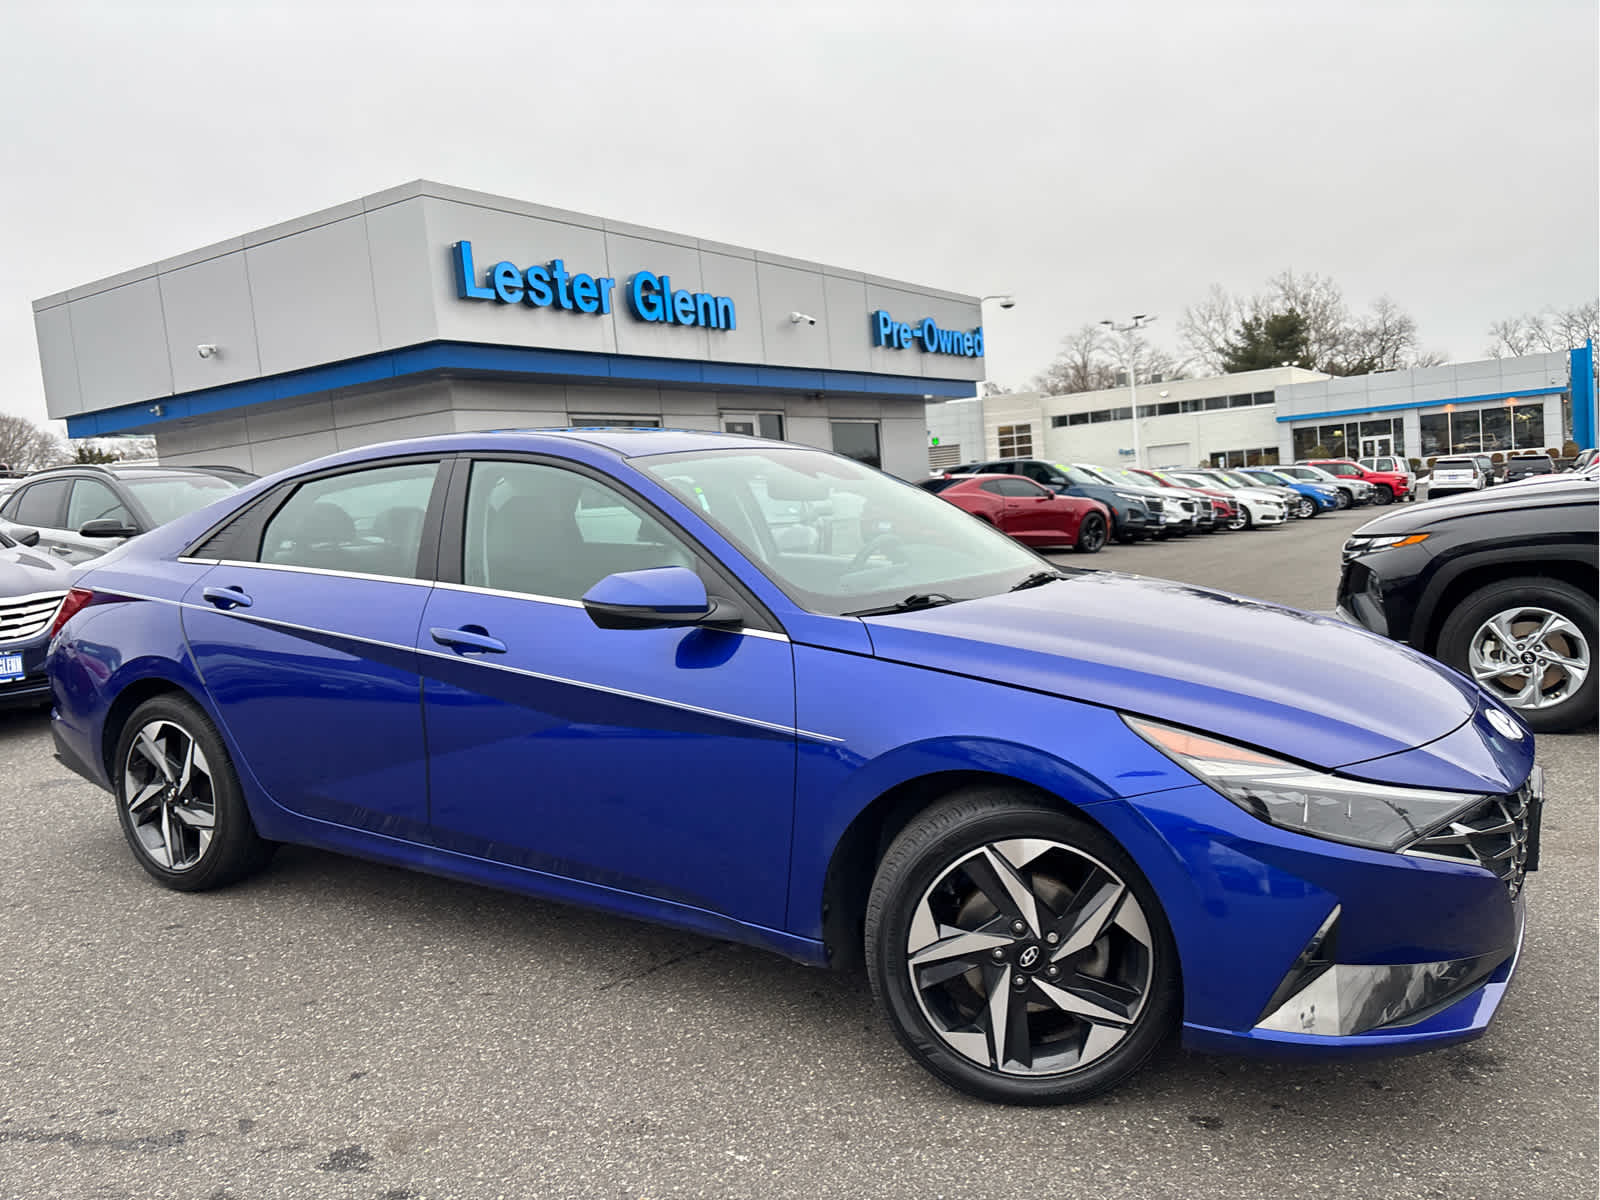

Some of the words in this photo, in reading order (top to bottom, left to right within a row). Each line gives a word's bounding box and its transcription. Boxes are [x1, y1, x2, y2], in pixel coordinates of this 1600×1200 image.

[453, 240, 615, 314] Lester
[627, 270, 736, 331] Glenn
[872, 310, 984, 357] Pre-Owned
